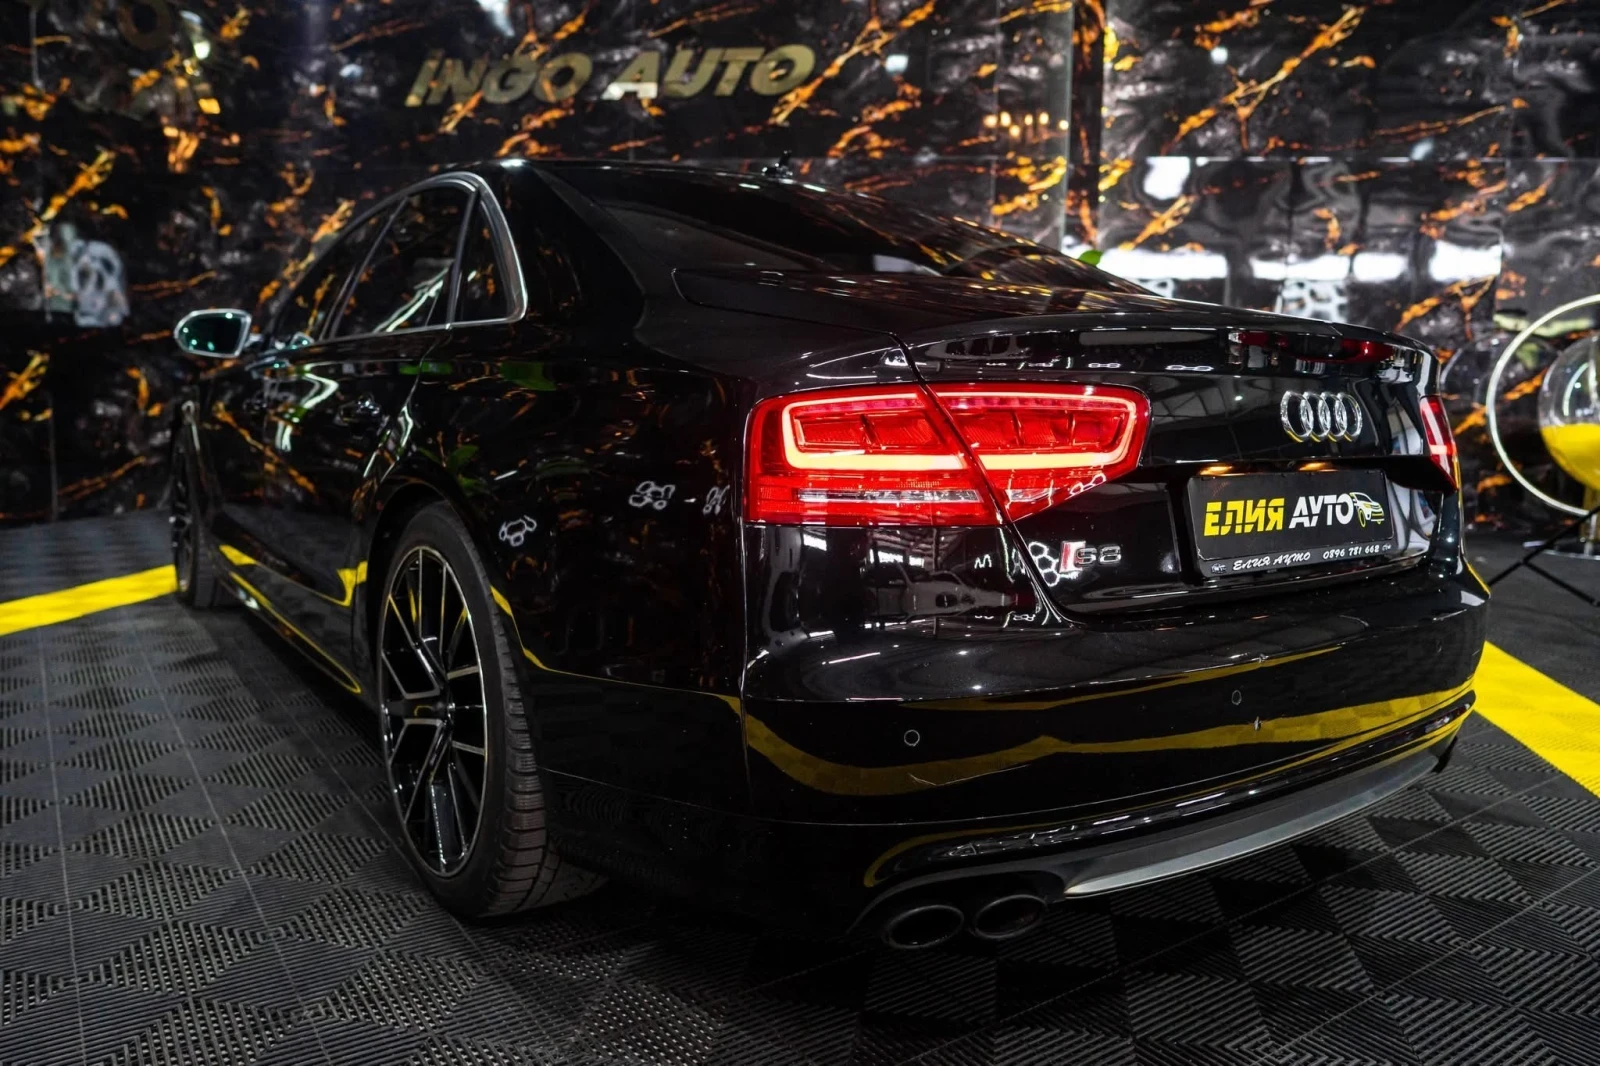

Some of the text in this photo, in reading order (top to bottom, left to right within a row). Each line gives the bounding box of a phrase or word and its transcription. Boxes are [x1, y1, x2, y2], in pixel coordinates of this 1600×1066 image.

[405, 44, 816, 107] INGO AUTO
[1204, 497, 1285, 537] ЕЛИЯ
[1075, 545, 1122, 567] S8
[1322, 547, 1346, 560] 0896
